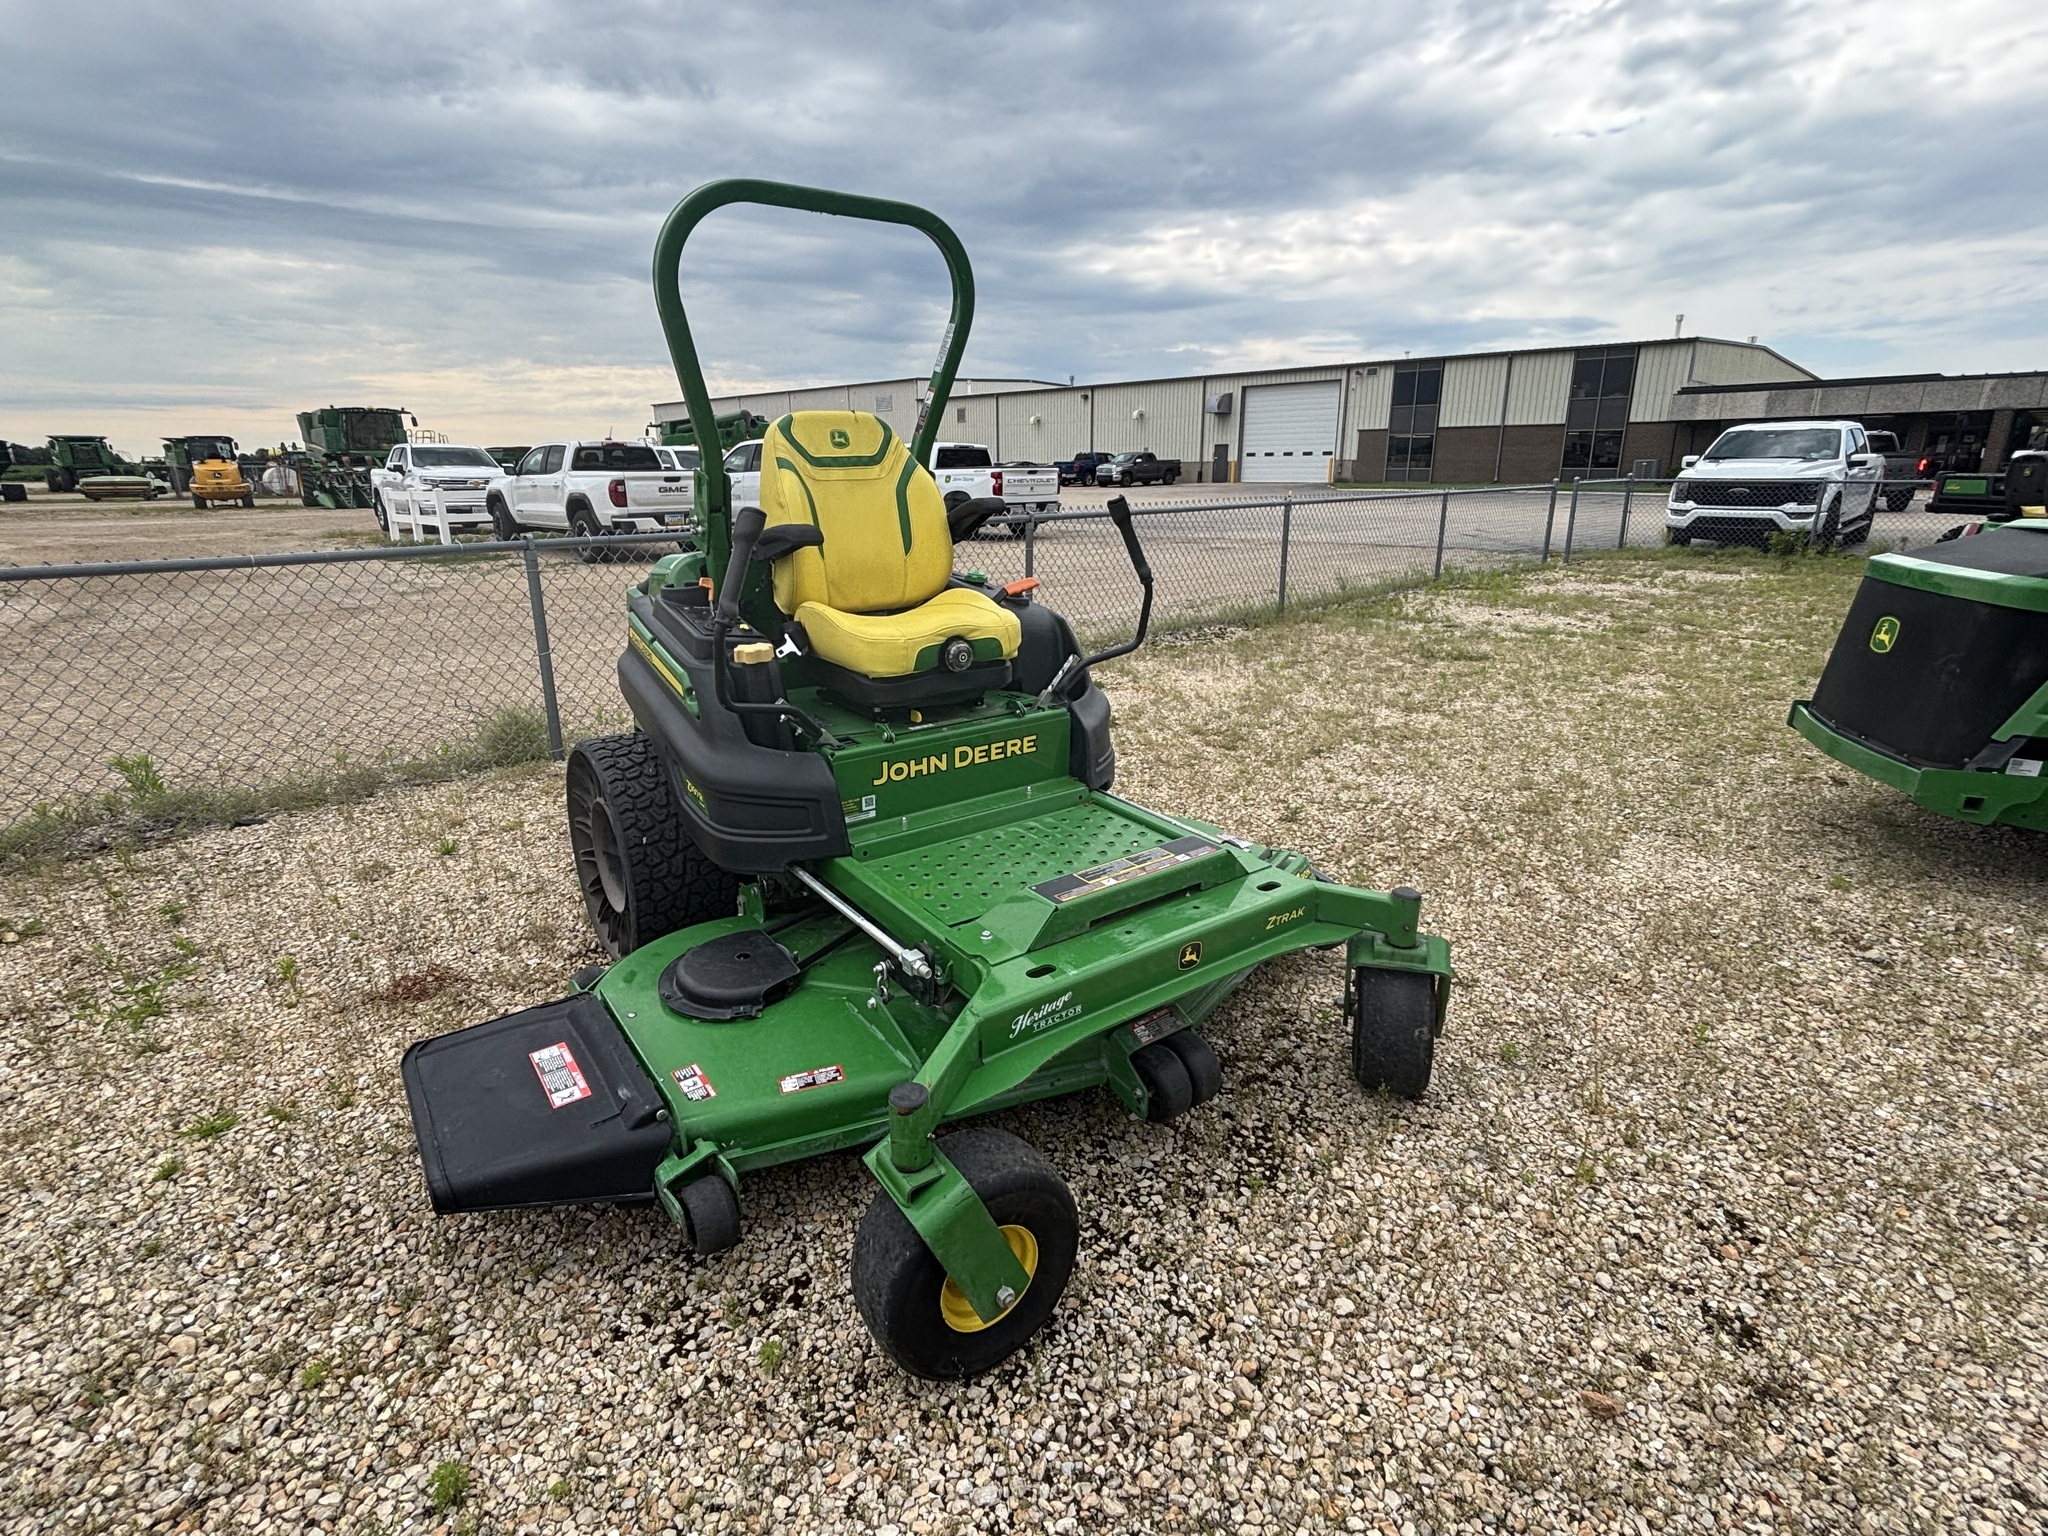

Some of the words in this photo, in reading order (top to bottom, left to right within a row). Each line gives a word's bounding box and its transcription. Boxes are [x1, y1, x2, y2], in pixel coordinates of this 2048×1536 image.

[658, 486, 689, 494] GMC
[873, 753, 947, 786] JOHN
[954, 734, 1037, 769] DEERE
[1265, 905, 1306, 931] ZTRAK
[1009, 991, 1073, 1039] Heritage
[1033, 1005, 1082, 1032] TRACTOR
